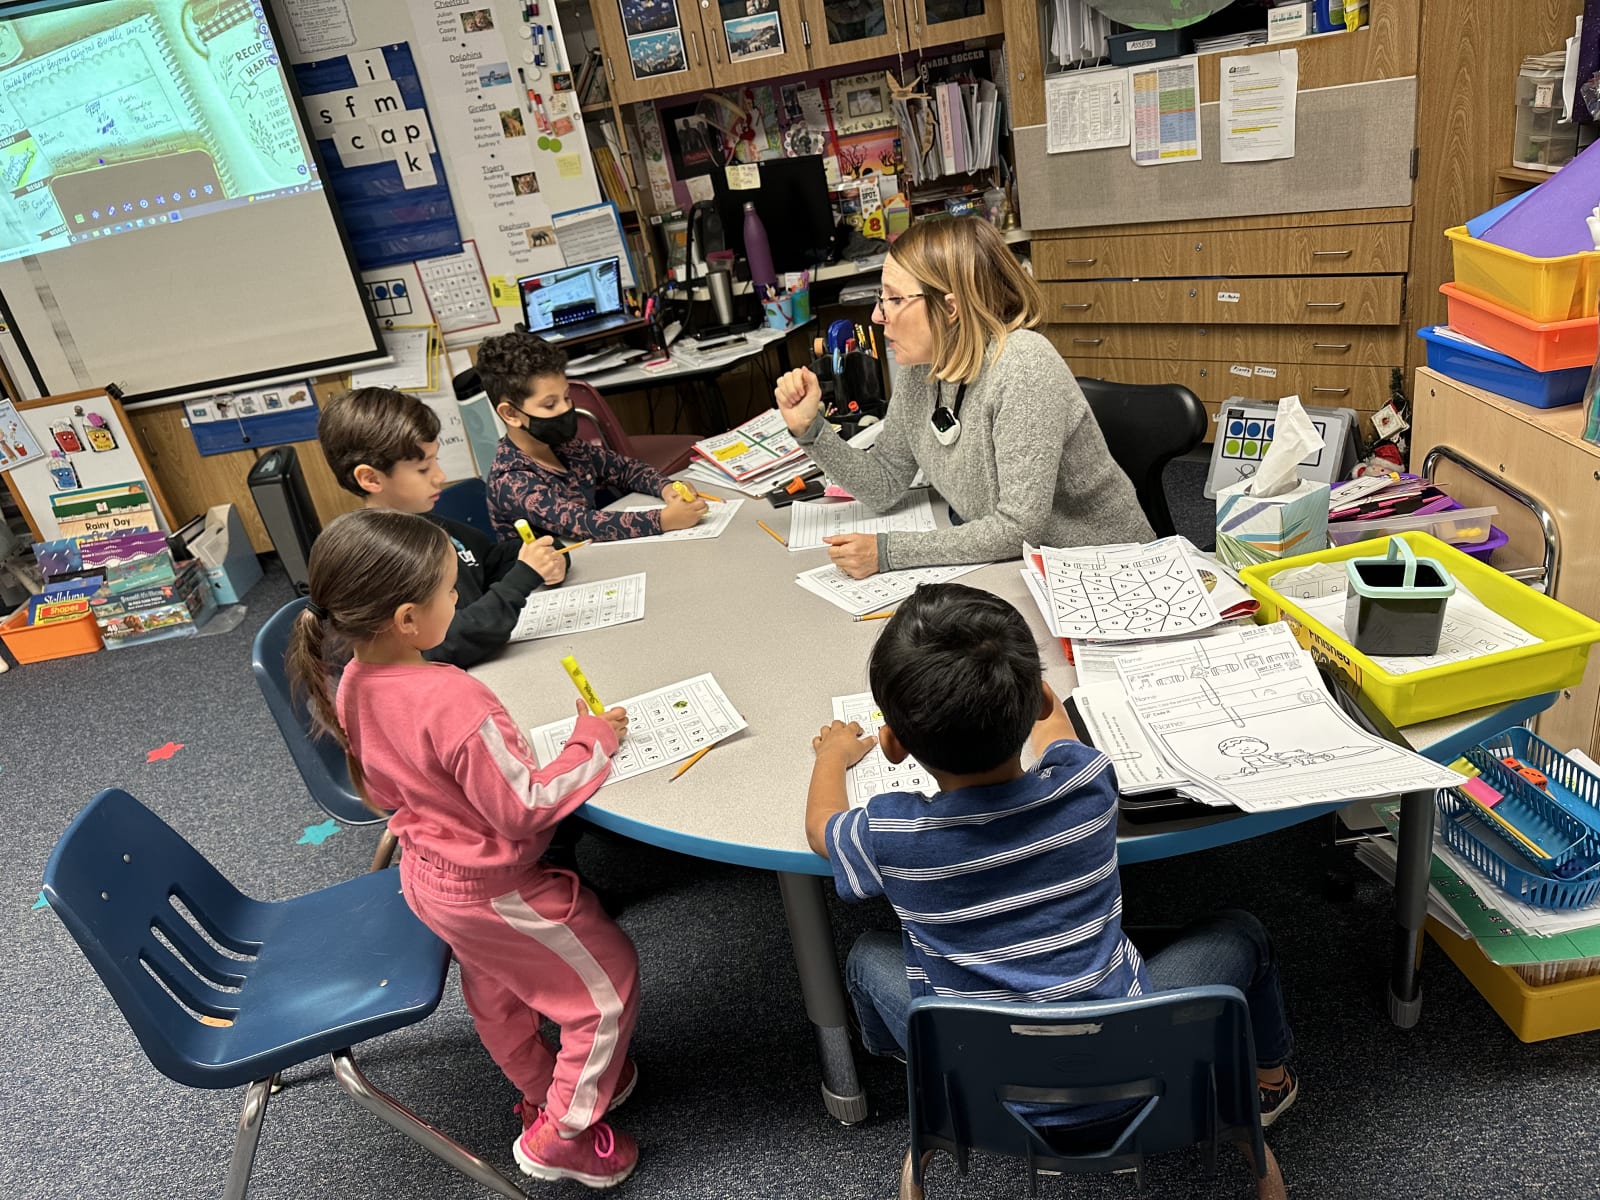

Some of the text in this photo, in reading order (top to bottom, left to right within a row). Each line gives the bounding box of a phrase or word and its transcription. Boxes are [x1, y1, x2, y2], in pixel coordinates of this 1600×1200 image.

[1130, 40, 1155, 49] ASSESS
[235, 42, 262, 62] RECIP
[449, 51, 482, 63] Dolphins
[952, 51, 985, 64] SOCCER
[245, 57, 270, 77] HAPP
[365, 59, 375, 80] i
[320, 95, 398, 124] s f m
[468, 103, 497, 114] Giraffes
[405, 151, 422, 172] k
[85, 518, 131, 531] Rainy Day
[50, 605, 79, 615] Shapes
[891, 780, 900, 788] d
